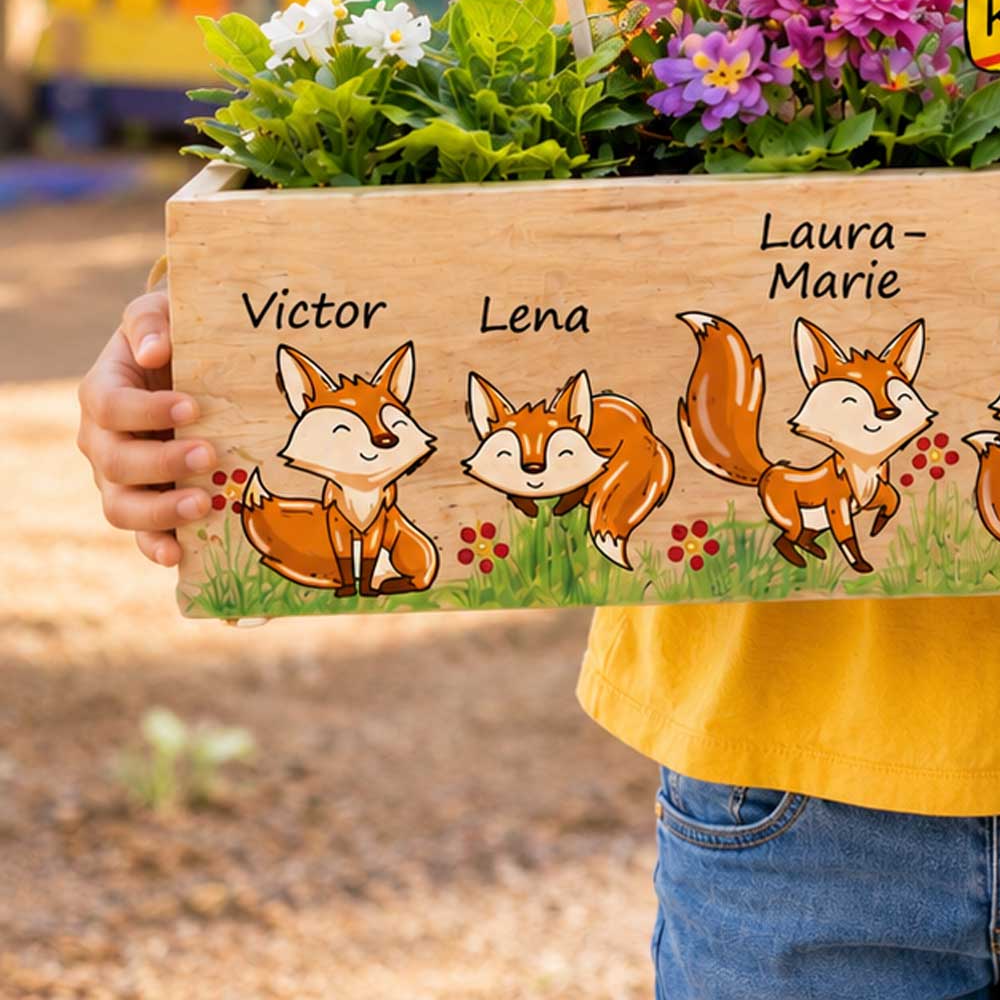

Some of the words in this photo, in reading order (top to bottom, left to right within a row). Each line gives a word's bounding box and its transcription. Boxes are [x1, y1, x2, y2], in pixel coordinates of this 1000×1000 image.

[770, 260, 902, 300] Marie
[243, 289, 388, 330] Victor
[481, 297, 590, 334] Lena
